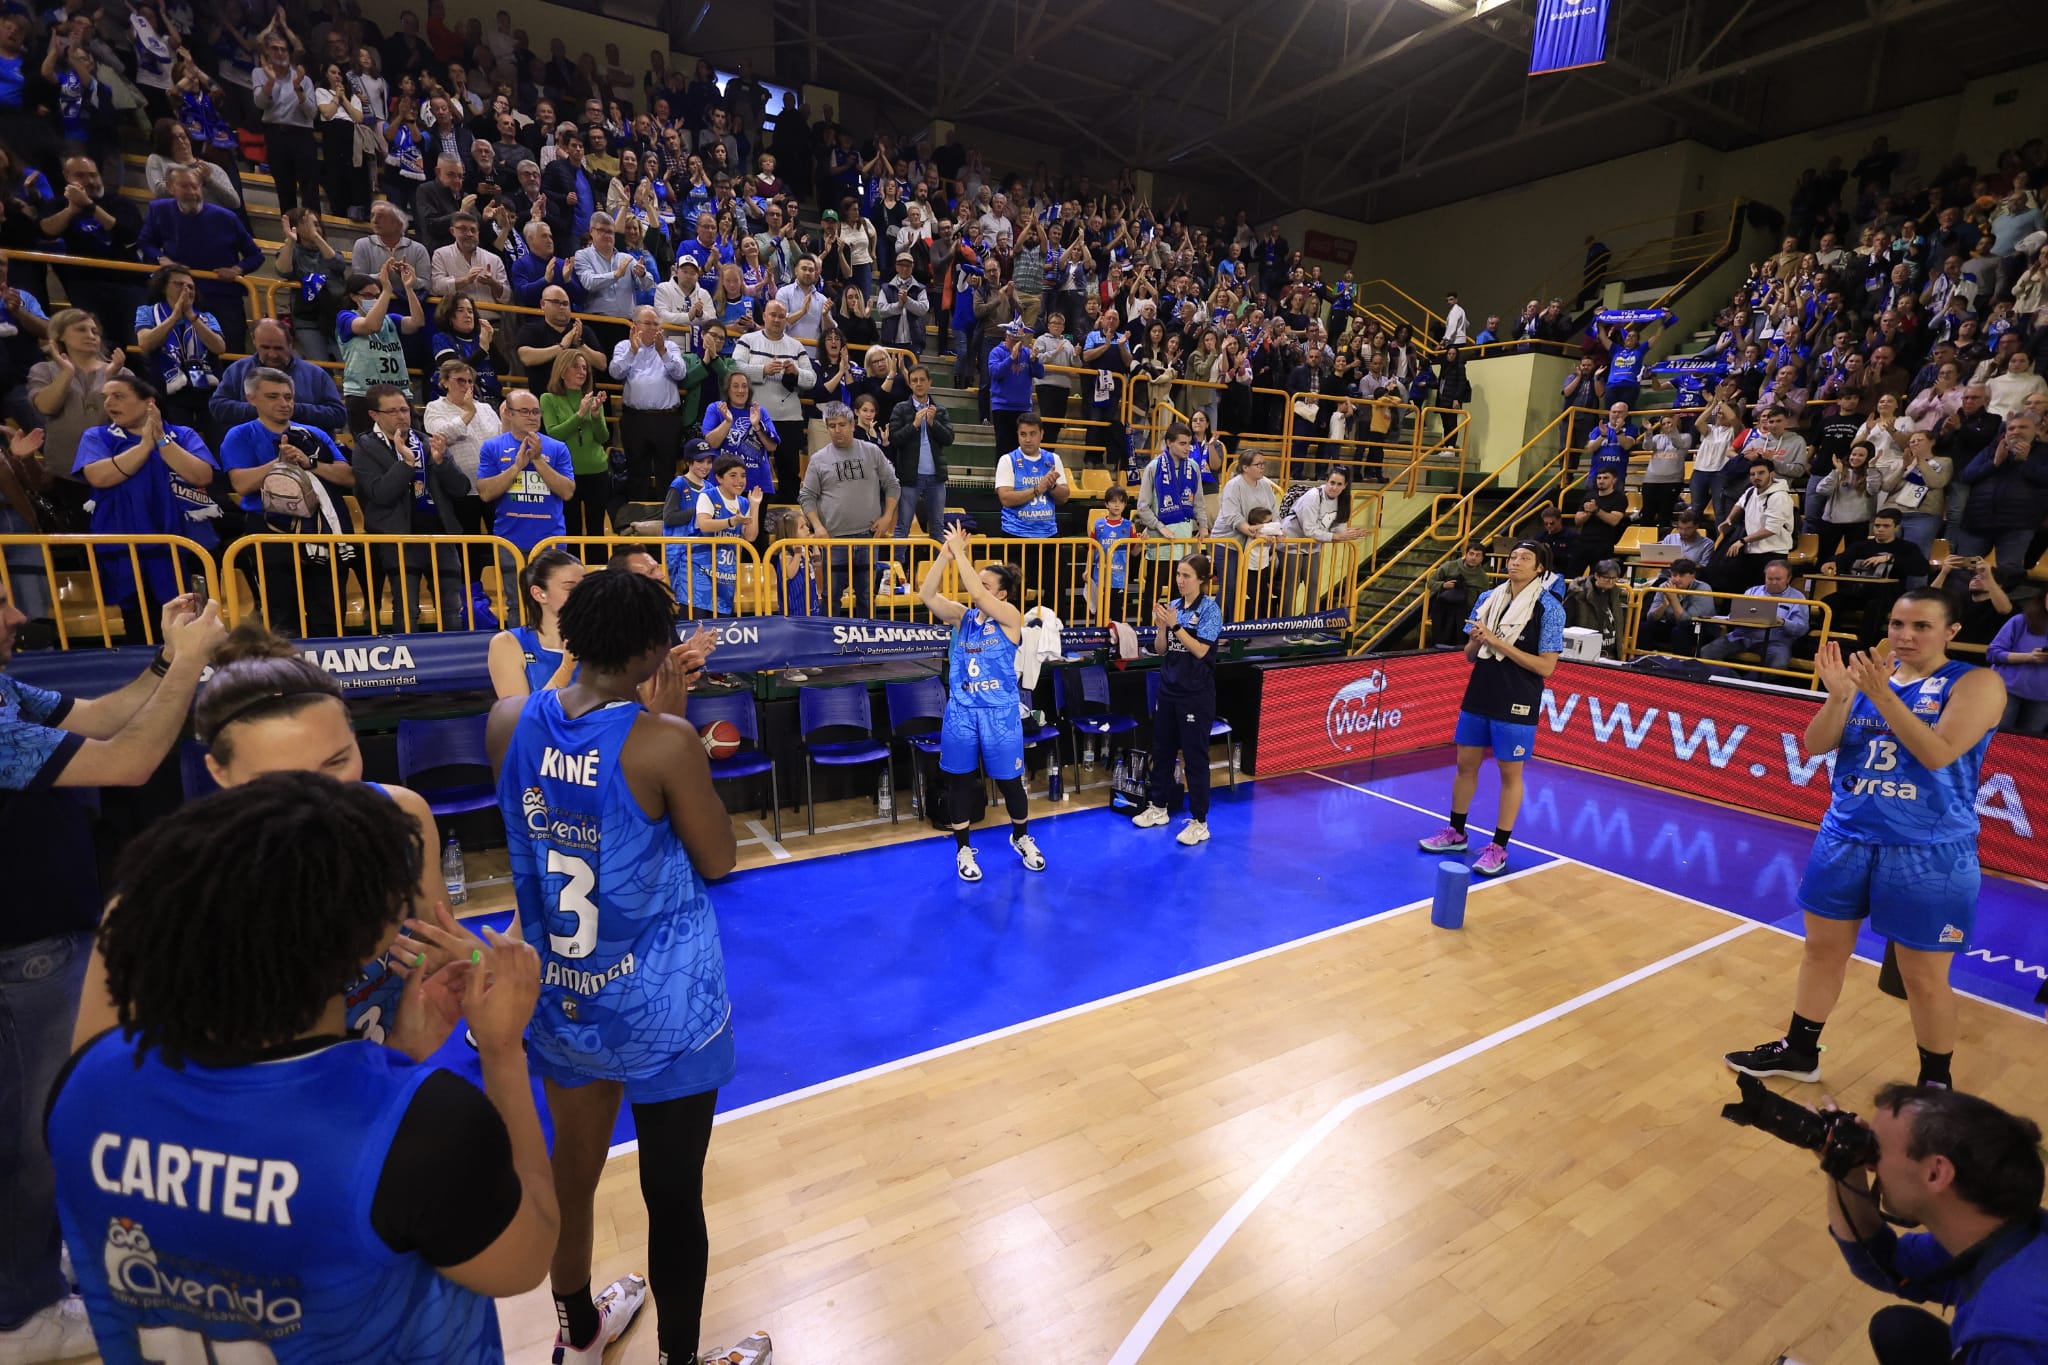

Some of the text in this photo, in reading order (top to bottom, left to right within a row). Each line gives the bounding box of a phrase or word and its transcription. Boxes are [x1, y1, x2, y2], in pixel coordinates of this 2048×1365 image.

[1550, 7, 1596, 21] SALAMANCA
[379, 357, 399, 374] 30
[1666, 360, 1717, 369] AVENIDA
[517, 494, 544, 503] MILAR
[718, 549, 734, 565] 30
[833, 625, 951, 644] SALAMANC
[968, 658, 980, 678] 6
[352, 676, 416, 688] Humanidad
[1335, 708, 1402, 736] WeAre
[1864, 740, 1898, 771] 13
[547, 849, 599, 959] 3
[91, 1132, 299, 1226] CARTER
